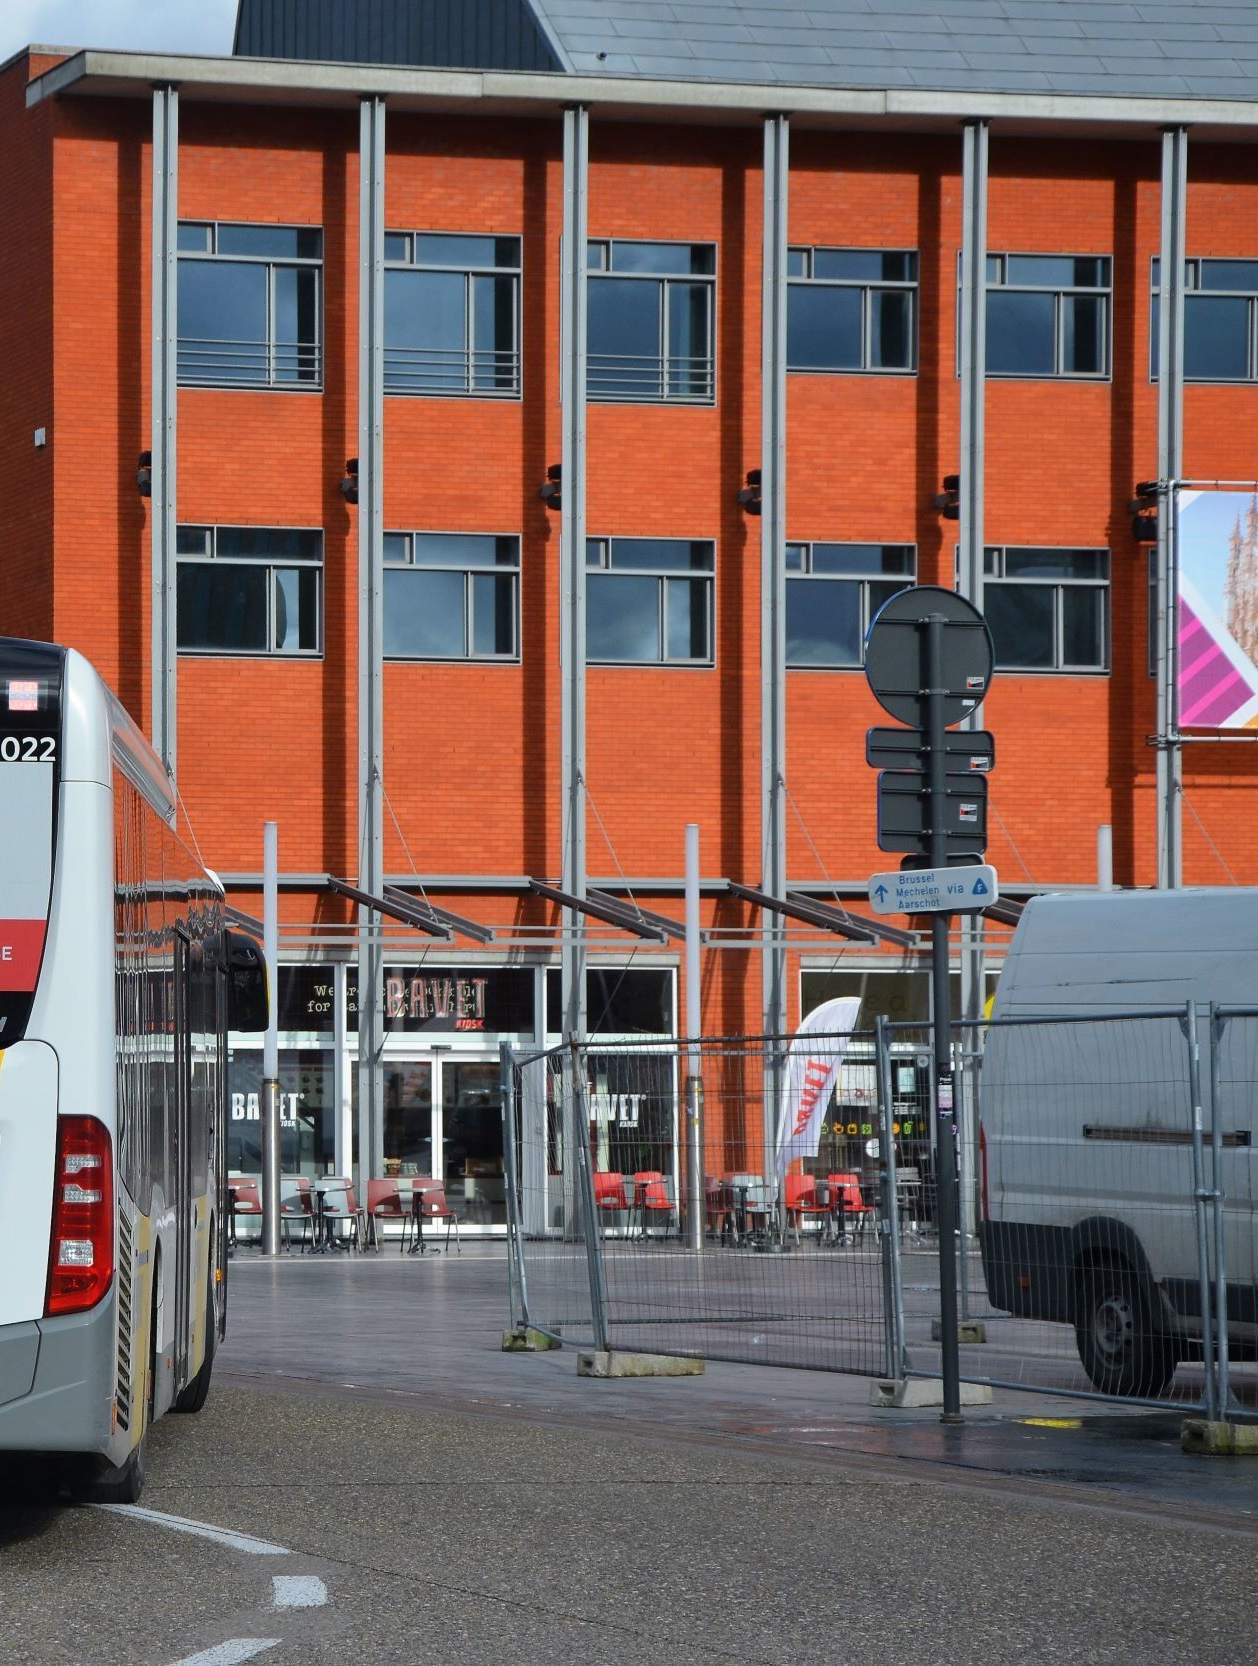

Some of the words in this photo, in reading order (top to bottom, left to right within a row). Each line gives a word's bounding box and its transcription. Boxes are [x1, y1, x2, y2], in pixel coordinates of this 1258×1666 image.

[899, 874, 934, 885] Brussel
[896, 887, 940, 898] Mechelen
[947, 884, 964, 895] via
[898, 898, 941, 910] Aarschot
[386, 977, 489, 1018] BAVET
[307, 1000, 331, 1013] for
[455, 1019, 484, 1029] KIOSK
[232, 1093, 298, 1120] BAET
[589, 1094, 641, 1121] AVET
